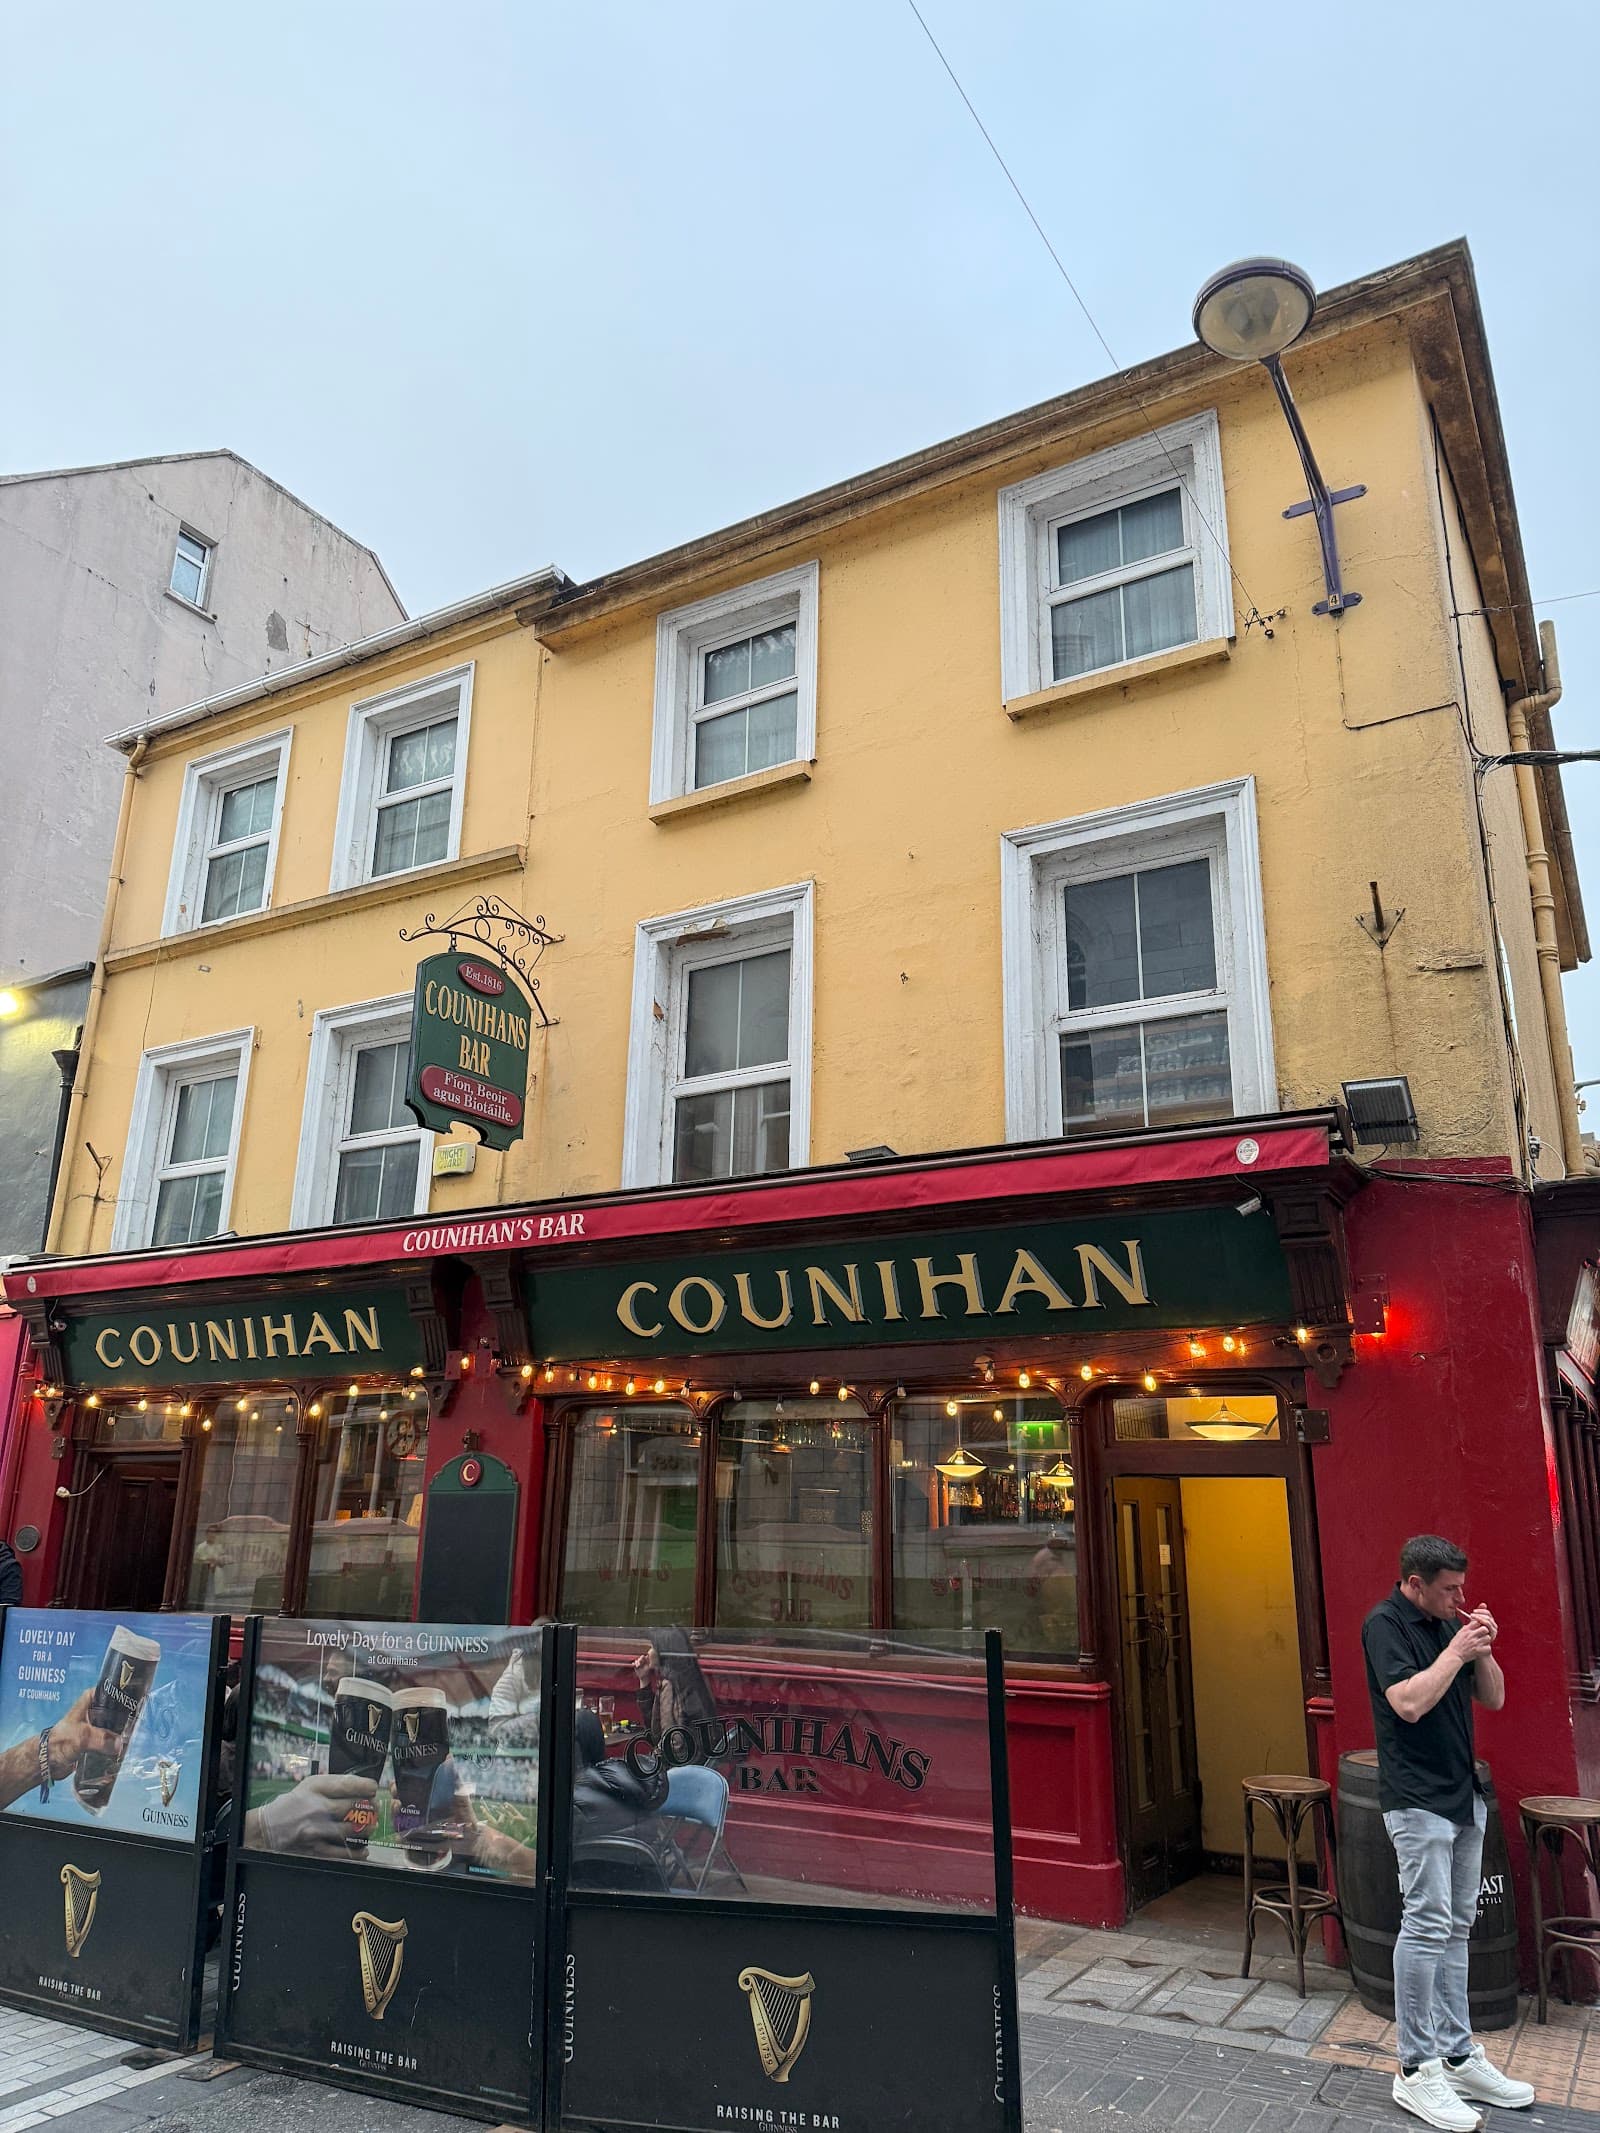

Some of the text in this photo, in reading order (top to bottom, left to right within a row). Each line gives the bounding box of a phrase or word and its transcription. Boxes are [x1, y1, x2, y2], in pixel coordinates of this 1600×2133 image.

[465, 965, 502, 991] Est.1816
[424, 980, 527, 1051] COUNIHANS
[459, 1035, 490, 1078] BAR
[444, 1072, 507, 1104] Fíon, Beoir
[433, 1087, 514, 1123] agus Biotáille.
[403, 1213, 586, 1252] COUNIHAN'S BAR
[615, 1239, 1158, 1338] COUNIHAN
[95, 1306, 384, 1369] COUNIHAN
[463, 1464, 475, 1481] C
[19, 1629, 76, 1646] LOVELY DAY
[306, 1629, 489, 1653] Lovely Day for a GUINNESS
[33, 1650, 52, 1662] FOR A
[368, 1656, 375, 1664] at
[18, 1666, 66, 1684] GUINNESS
[103, 1679, 138, 1711] GUINNESS
[394, 1743, 437, 1760] GUINNESS
[624, 1711, 934, 1791] COUNIHANS
[736, 1764, 825, 1794] BAR
[142, 1807, 189, 1827] GUINNESS
[38, 1975, 67, 1993] RAISING
[70, 1983, 84, 1996] THE
[86, 1988, 101, 2001] BAR
[330, 2040, 418, 2071] RAISING THE BAR
[716, 2105, 840, 2129] RAISING THE BAR
[758, 2121, 798, 2133] GUINNESS
